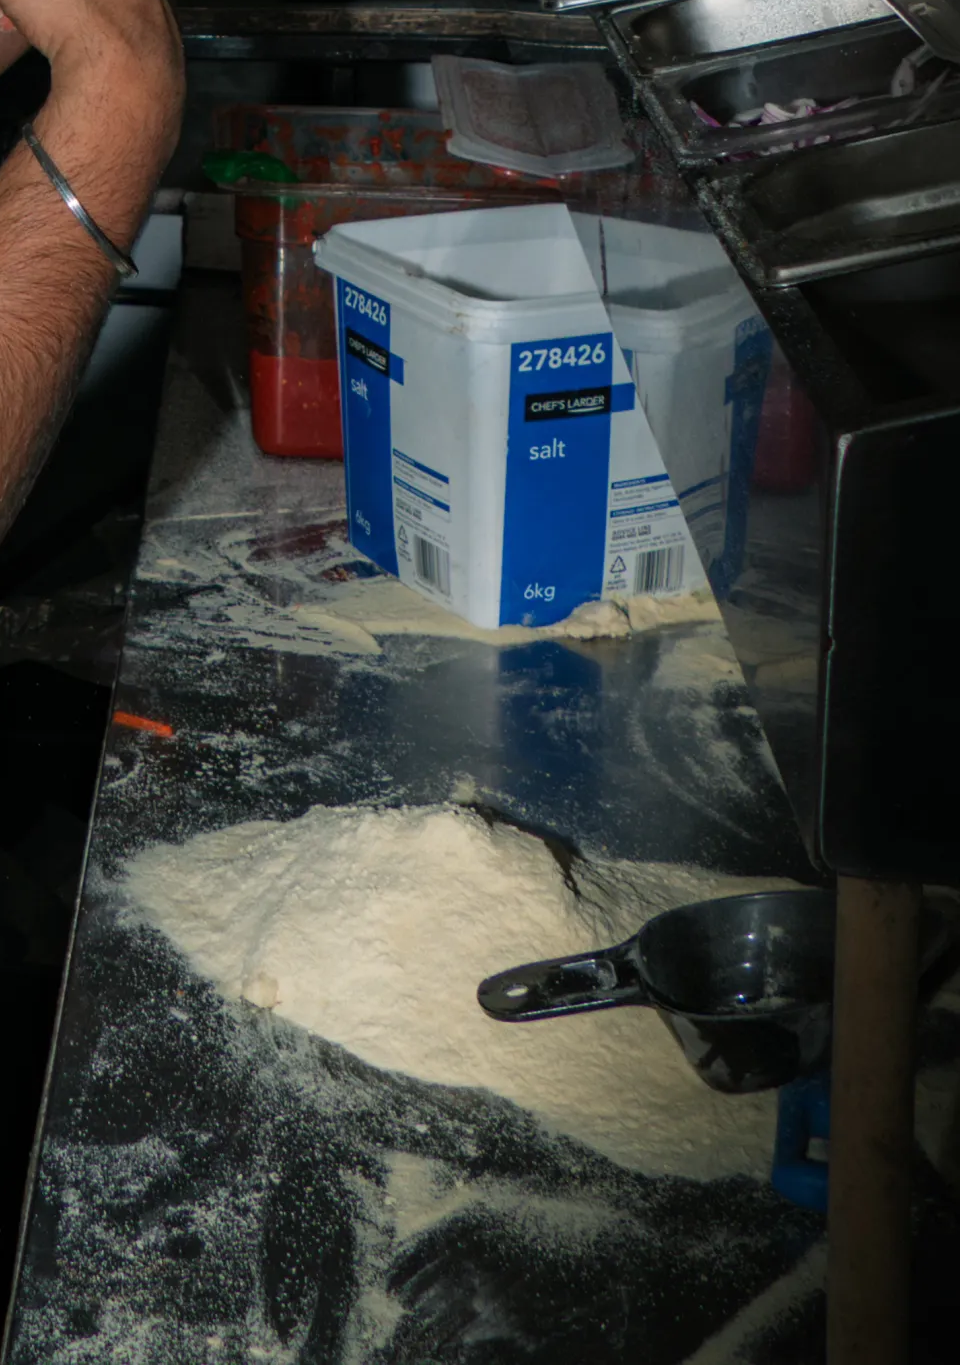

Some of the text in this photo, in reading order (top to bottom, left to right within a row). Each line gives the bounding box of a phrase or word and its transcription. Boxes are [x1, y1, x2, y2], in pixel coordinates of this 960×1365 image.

[344, 286, 387, 326] 278426
[518, 342, 606, 372] 278426
[350, 377, 369, 401] salt
[531, 395, 605, 412] CHEF'S LARDER
[529, 437, 566, 461] salt
[355, 509, 371, 535] 6kg
[523, 583, 556, 602] 6kg
